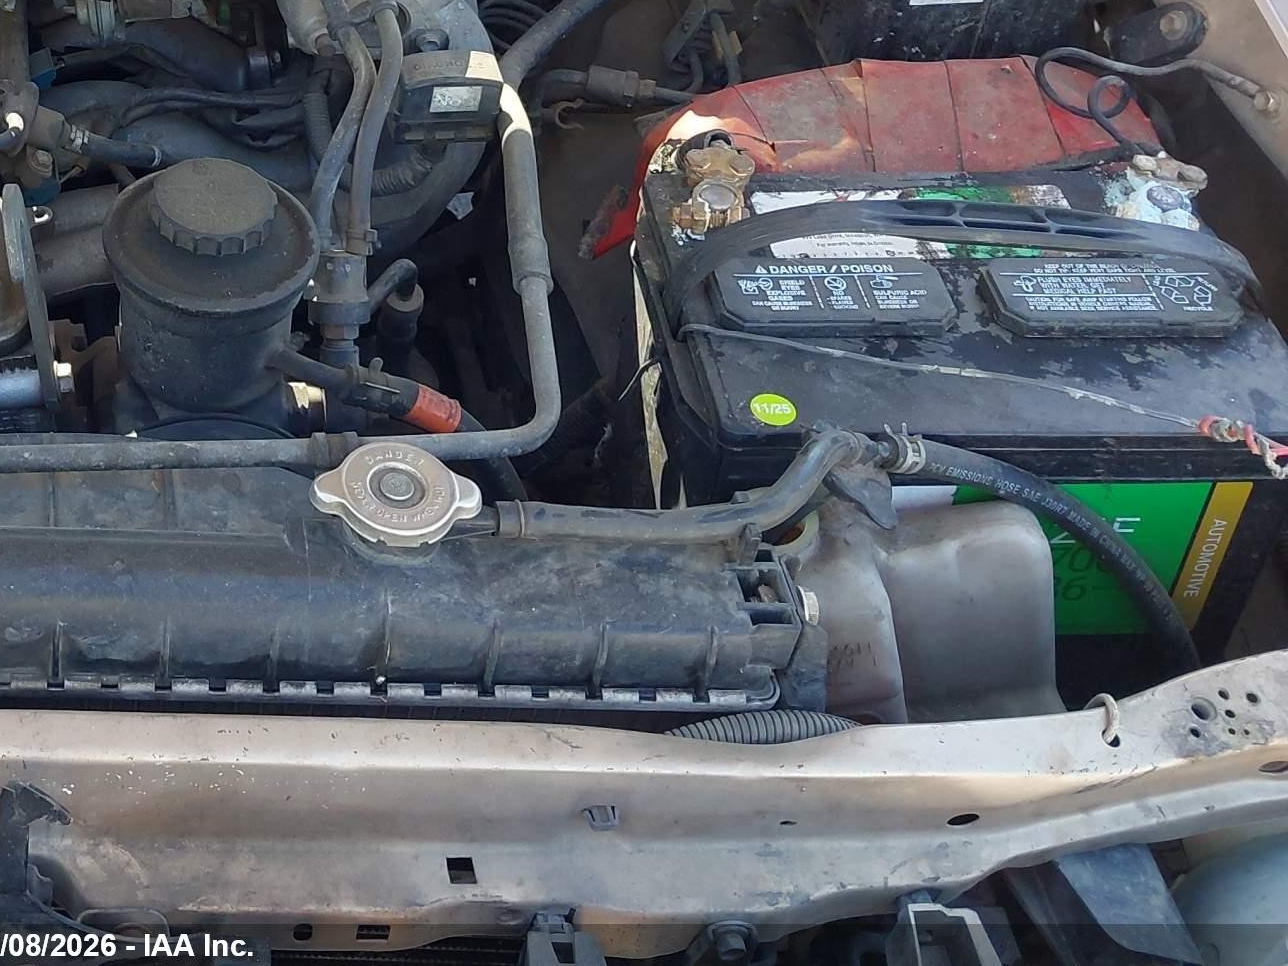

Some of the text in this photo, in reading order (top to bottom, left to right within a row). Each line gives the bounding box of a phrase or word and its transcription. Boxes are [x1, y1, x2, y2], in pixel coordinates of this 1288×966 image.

[769, 265, 827, 274] DANGER
[840, 264, 894, 273] POISON
[753, 403, 791, 414] 11/25
[365, 450, 425, 465] DANGER
[946, 466, 993, 486] EMISSIONS
[994, 478, 1021, 494] HOSE
[1021, 487, 1041, 503] SAE
[377, 508, 407, 522] OPEN
[1184, 518, 1228, 597] AUTOMOTIVE
